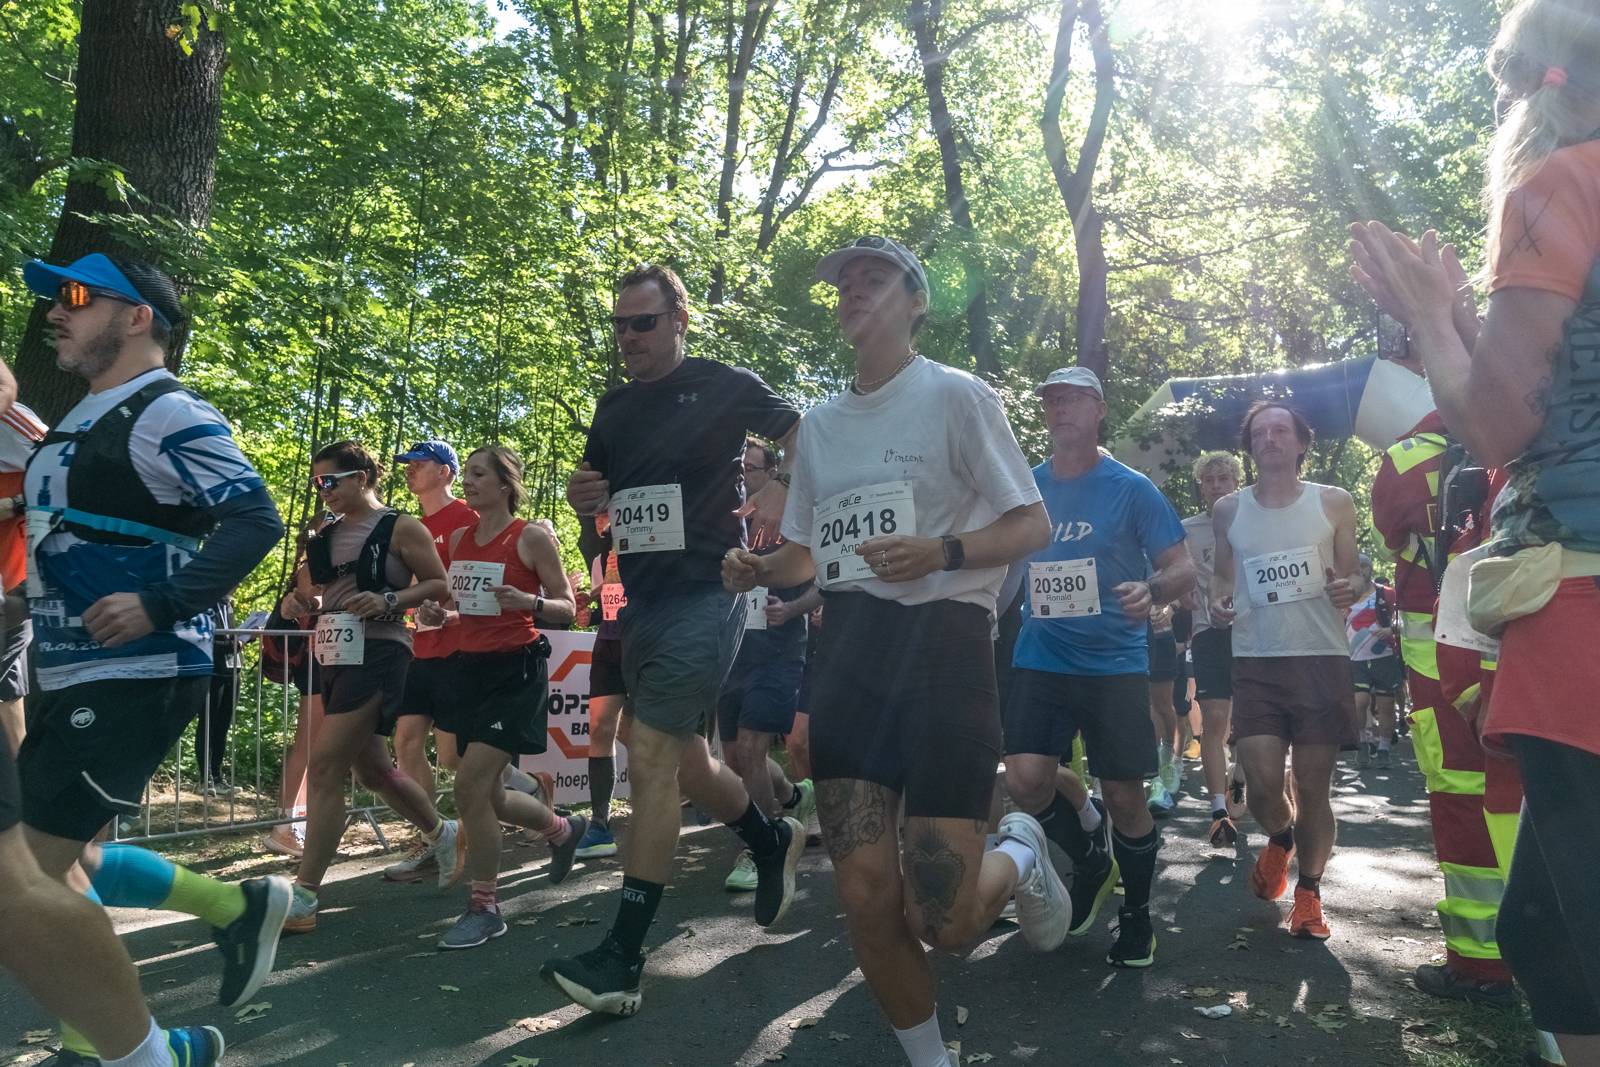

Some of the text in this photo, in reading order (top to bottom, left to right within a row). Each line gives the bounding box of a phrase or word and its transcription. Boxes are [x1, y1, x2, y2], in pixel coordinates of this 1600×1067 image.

[615, 503, 669, 527] 20419
[625, 526, 653, 535] Tommy
[820, 508, 897, 549] 20418
[840, 543, 863, 555] Ann
[1256, 561, 1310, 584] 20001
[452, 575, 492, 591] 20275
[1034, 575, 1086, 594] 20380
[1046, 593, 1072, 601] Ronald
[317, 628, 354, 644] 20273
